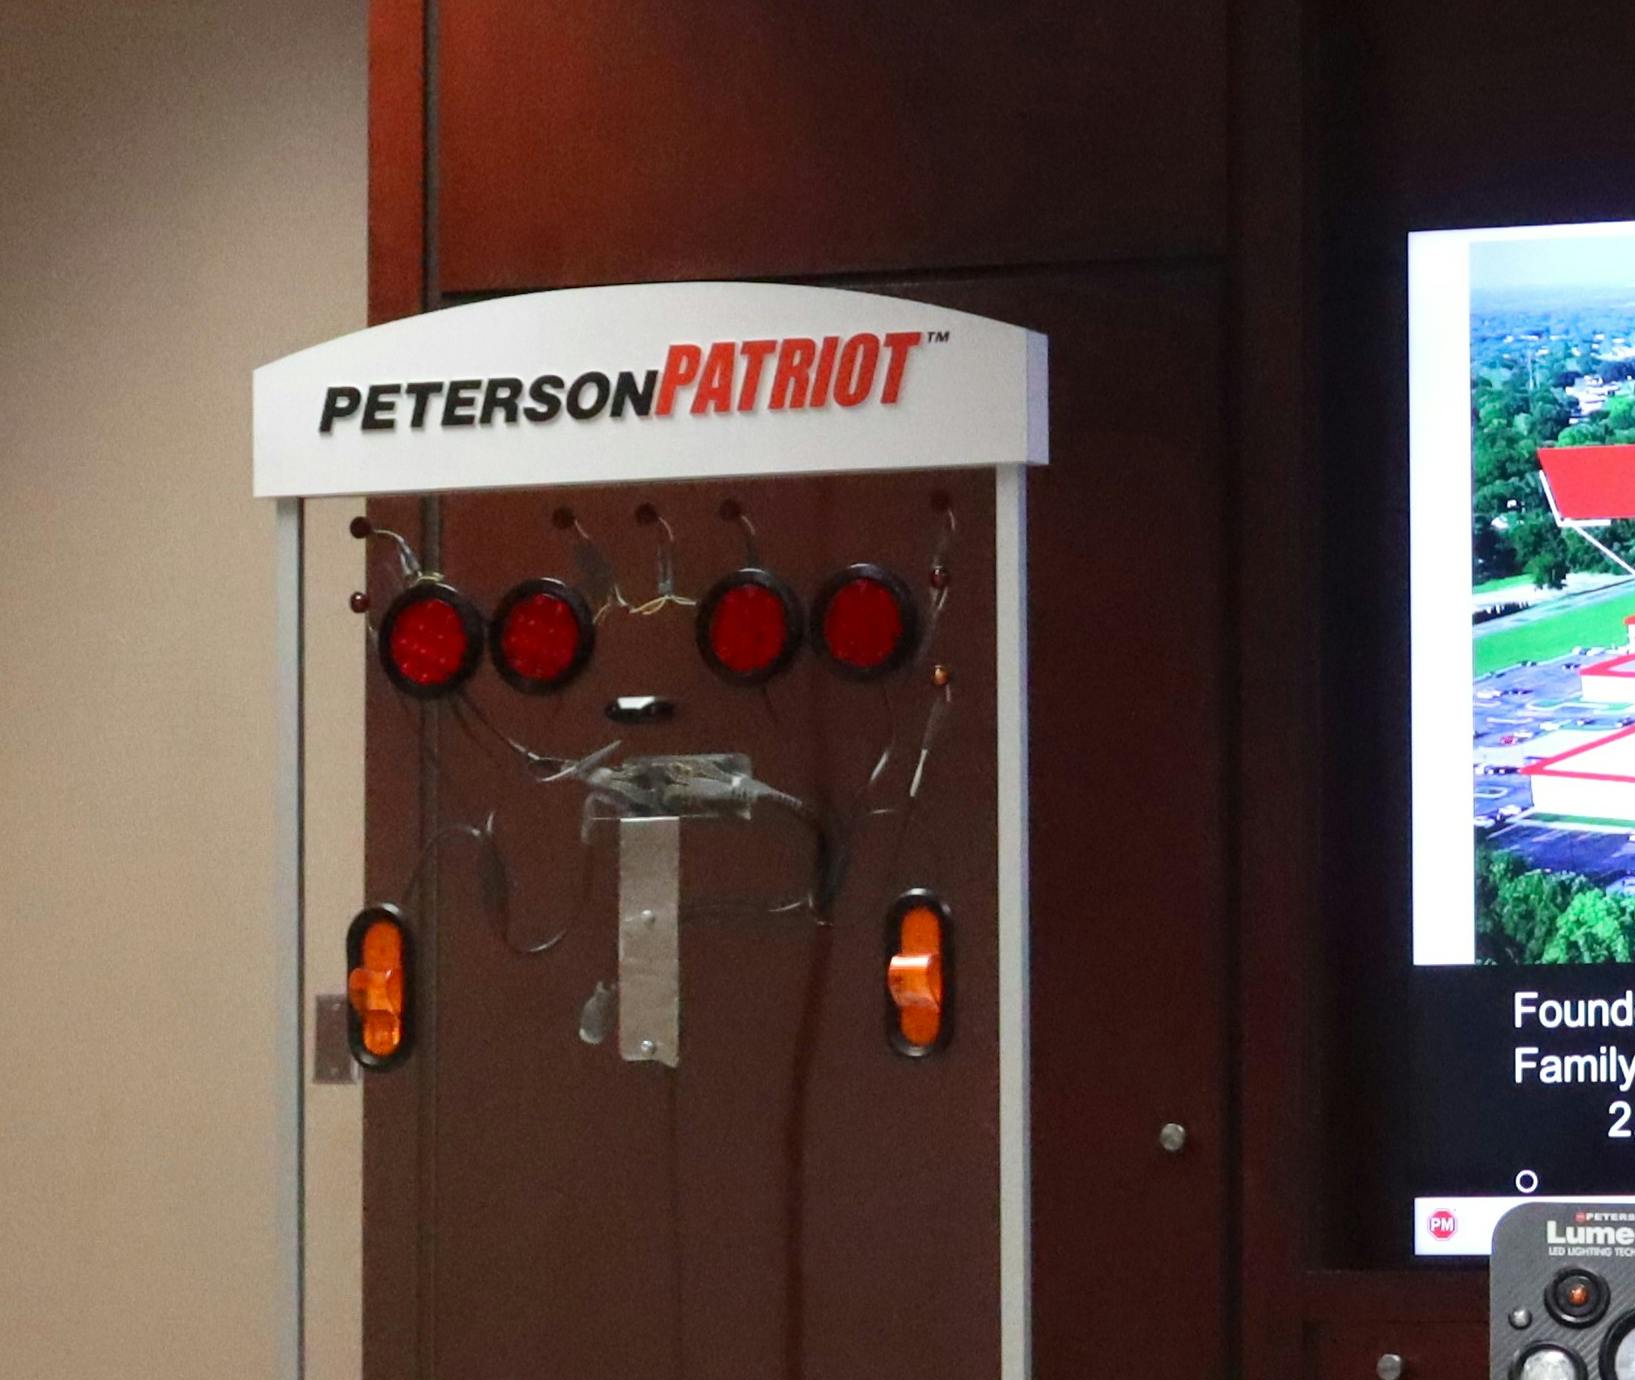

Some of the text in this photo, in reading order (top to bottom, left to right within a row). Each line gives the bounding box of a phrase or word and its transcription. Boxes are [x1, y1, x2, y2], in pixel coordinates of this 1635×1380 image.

[1430, 1217, 1454, 1232] PM
[1548, 1246, 1566, 1257] LED
[1567, 1246, 1613, 1257] LIGHTING
